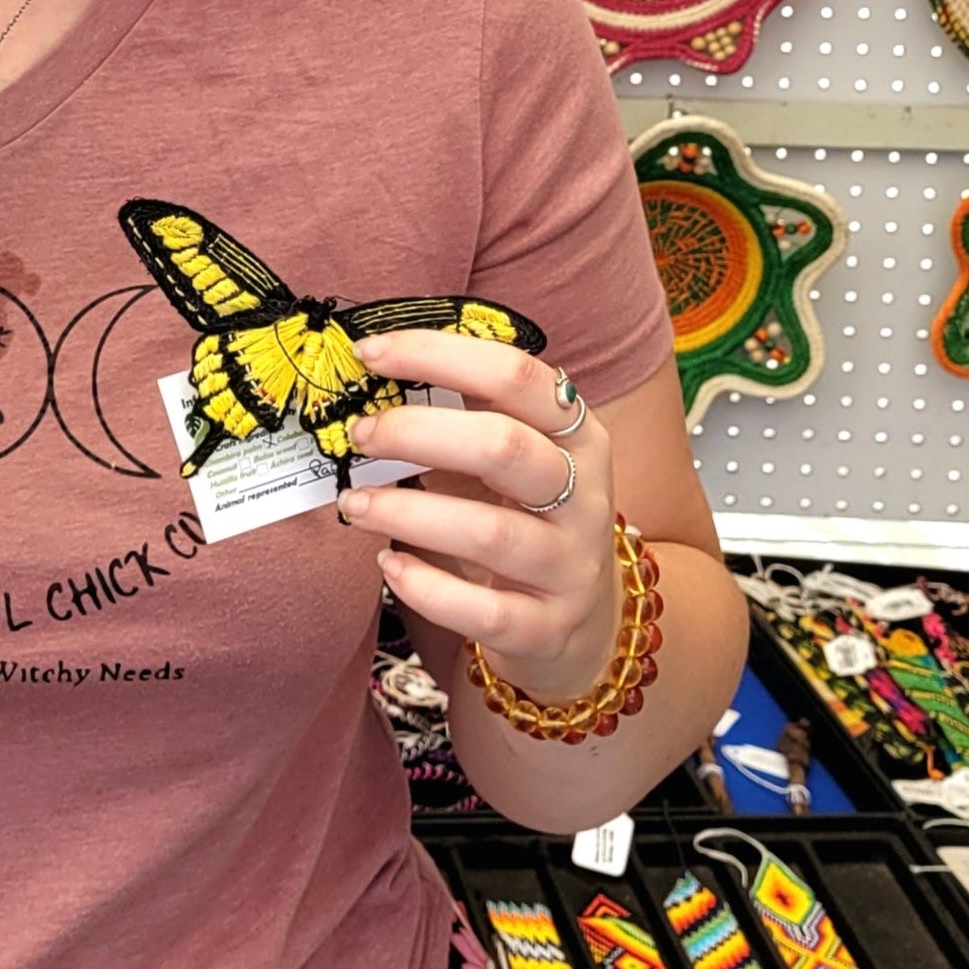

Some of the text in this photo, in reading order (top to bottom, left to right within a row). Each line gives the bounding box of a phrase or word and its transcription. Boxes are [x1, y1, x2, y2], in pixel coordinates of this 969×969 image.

[214, 477, 298, 512] Animal represented
[46, 542, 171, 622] CHICK
[100, 661, 185, 682] Needs
